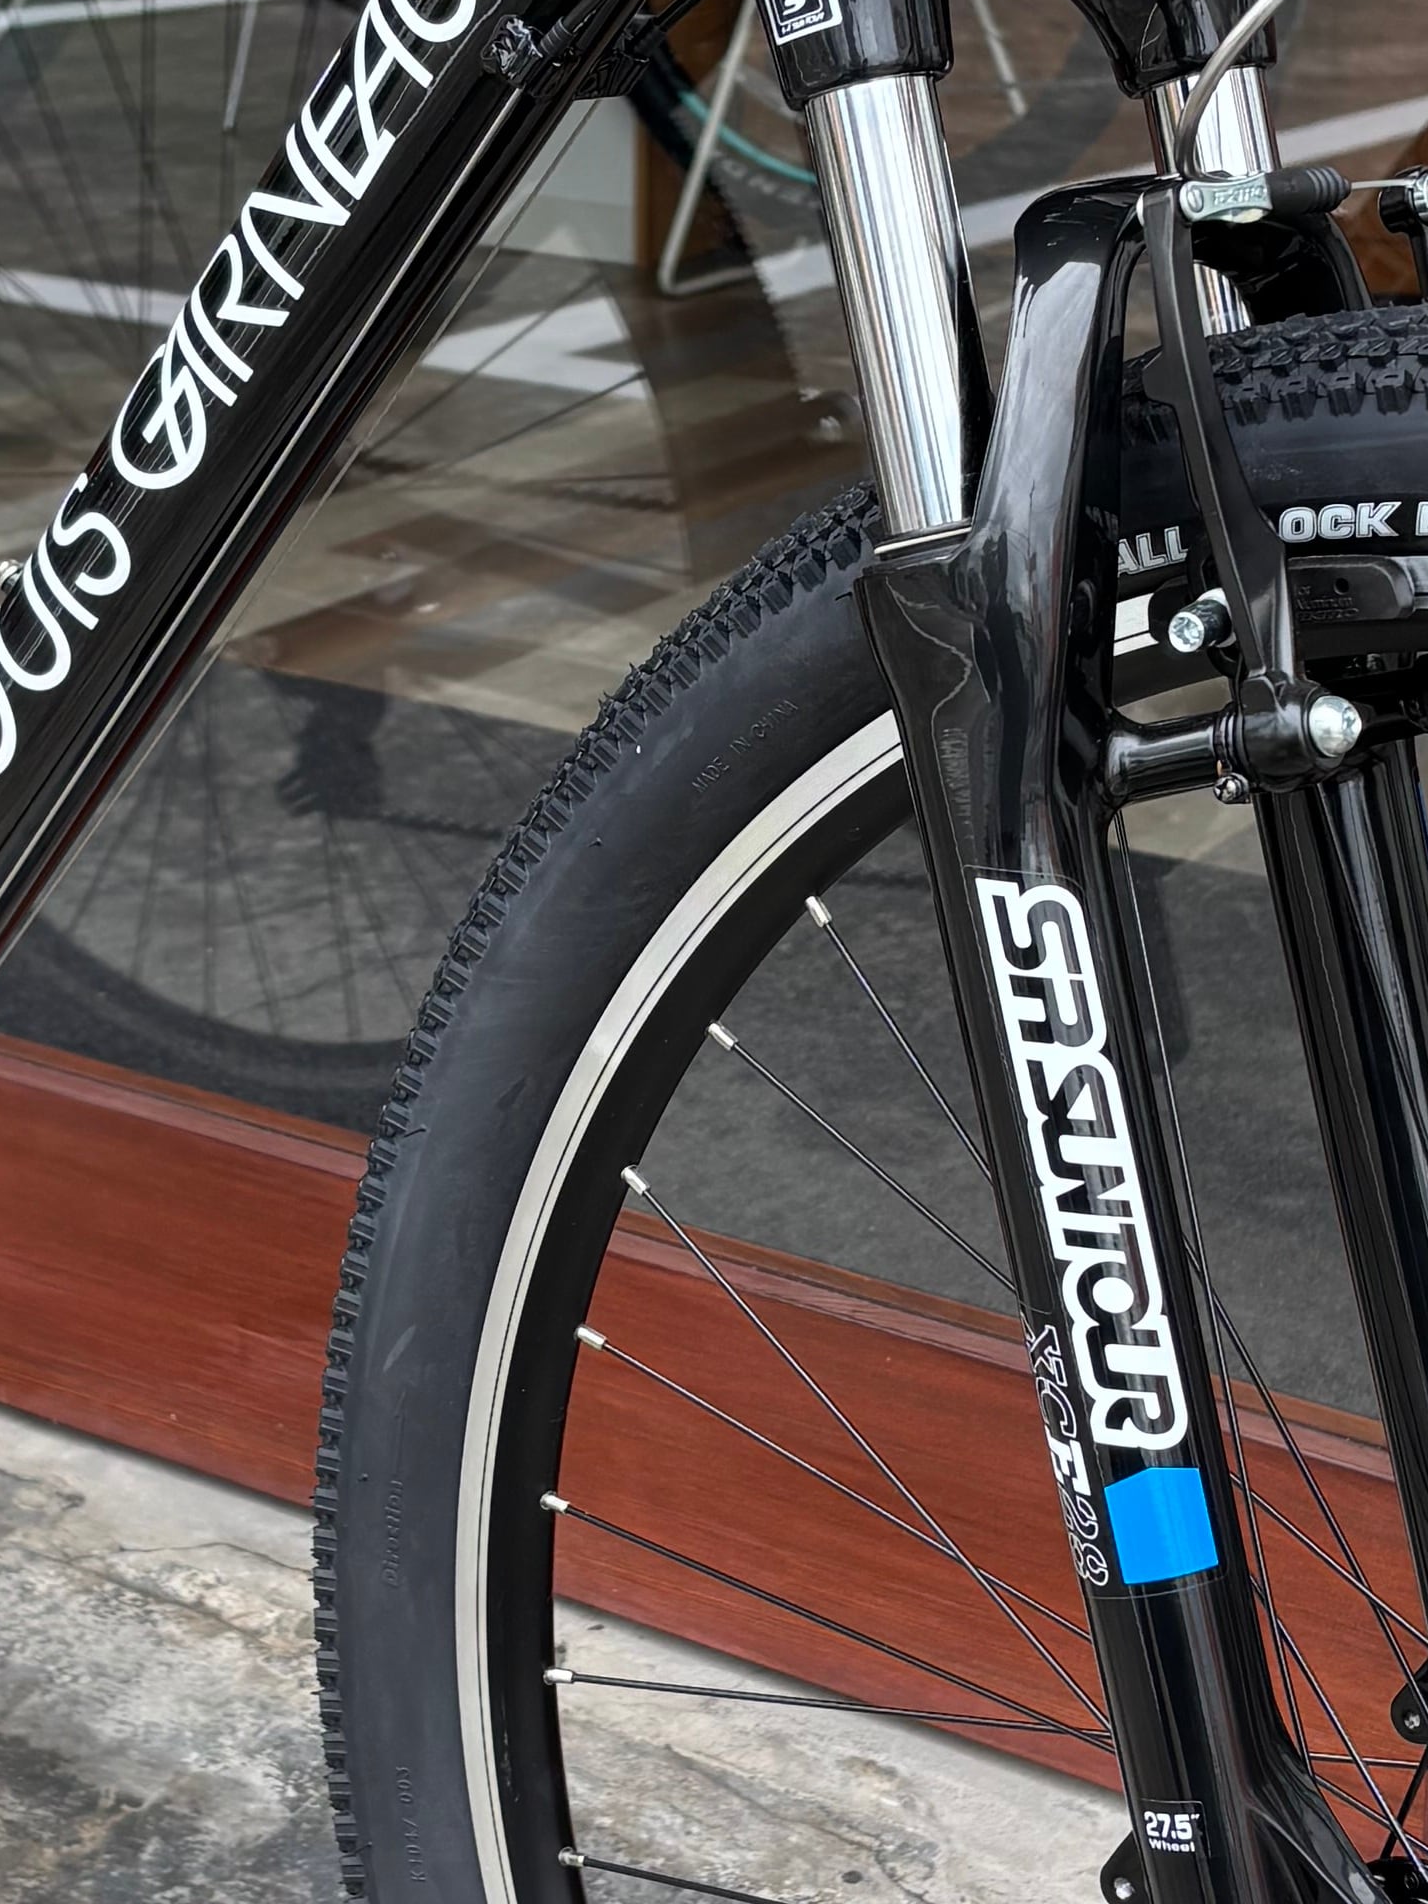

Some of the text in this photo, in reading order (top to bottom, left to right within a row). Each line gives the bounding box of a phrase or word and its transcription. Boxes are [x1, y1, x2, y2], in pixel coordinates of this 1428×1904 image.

[1117, 526, 1189, 578] ALL
[1278, 501, 1403, 544] OCK
[692, 756, 730, 793] MADE
[729, 736, 751, 754] IN
[1024, 1046, 1192, 1452] SUNTOUR
[1149, 1838, 1195, 1853] Wheel
